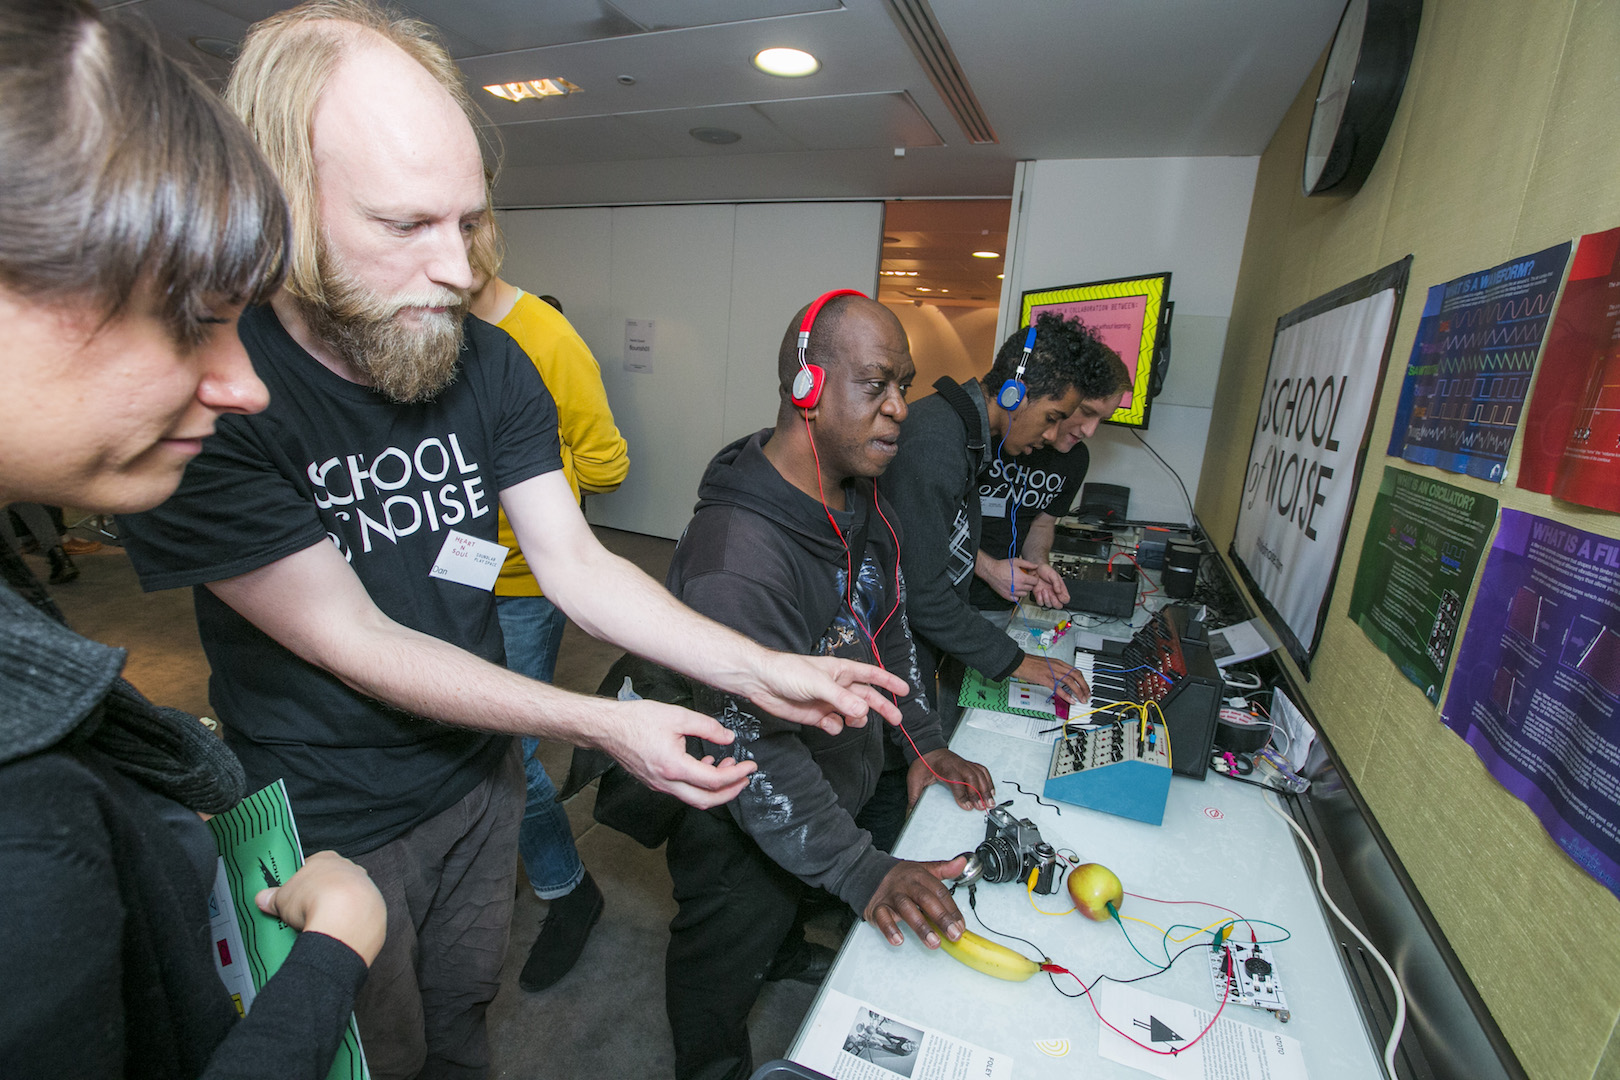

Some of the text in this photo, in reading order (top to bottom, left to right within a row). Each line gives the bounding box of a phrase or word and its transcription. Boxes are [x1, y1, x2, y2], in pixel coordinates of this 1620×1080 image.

[1069, 304, 1109, 314] COLLABORATION
[1111, 302, 1139, 311] BETWEEN:
[1262, 375, 1348, 452] SCHOOL
[306, 432, 479, 510] SCHOOL
[988, 458, 1067, 493] SCHOOL
[978, 482, 1008, 498] of
[1005, 486, 1059, 510] NOIS
[1248, 444, 1274, 511] of
[1266, 446, 1335, 542] NOISE
[1429, 483, 1476, 511] OSCILLATOR?
[356, 475, 490, 554] NOISE
[452, 548, 469, 558] SOUL
[455, 536, 476, 547] HEART
[1533, 521, 1566, 548] WHAT
[1564, 533, 1579, 553] IS
[1577, 539, 1591, 559] A
[432, 565, 448, 576] Dan
[1587, 808, 1607, 825] content
[1274, 1035, 1286, 1056] OTOTO
[985, 1056, 995, 1078] FOLEY
